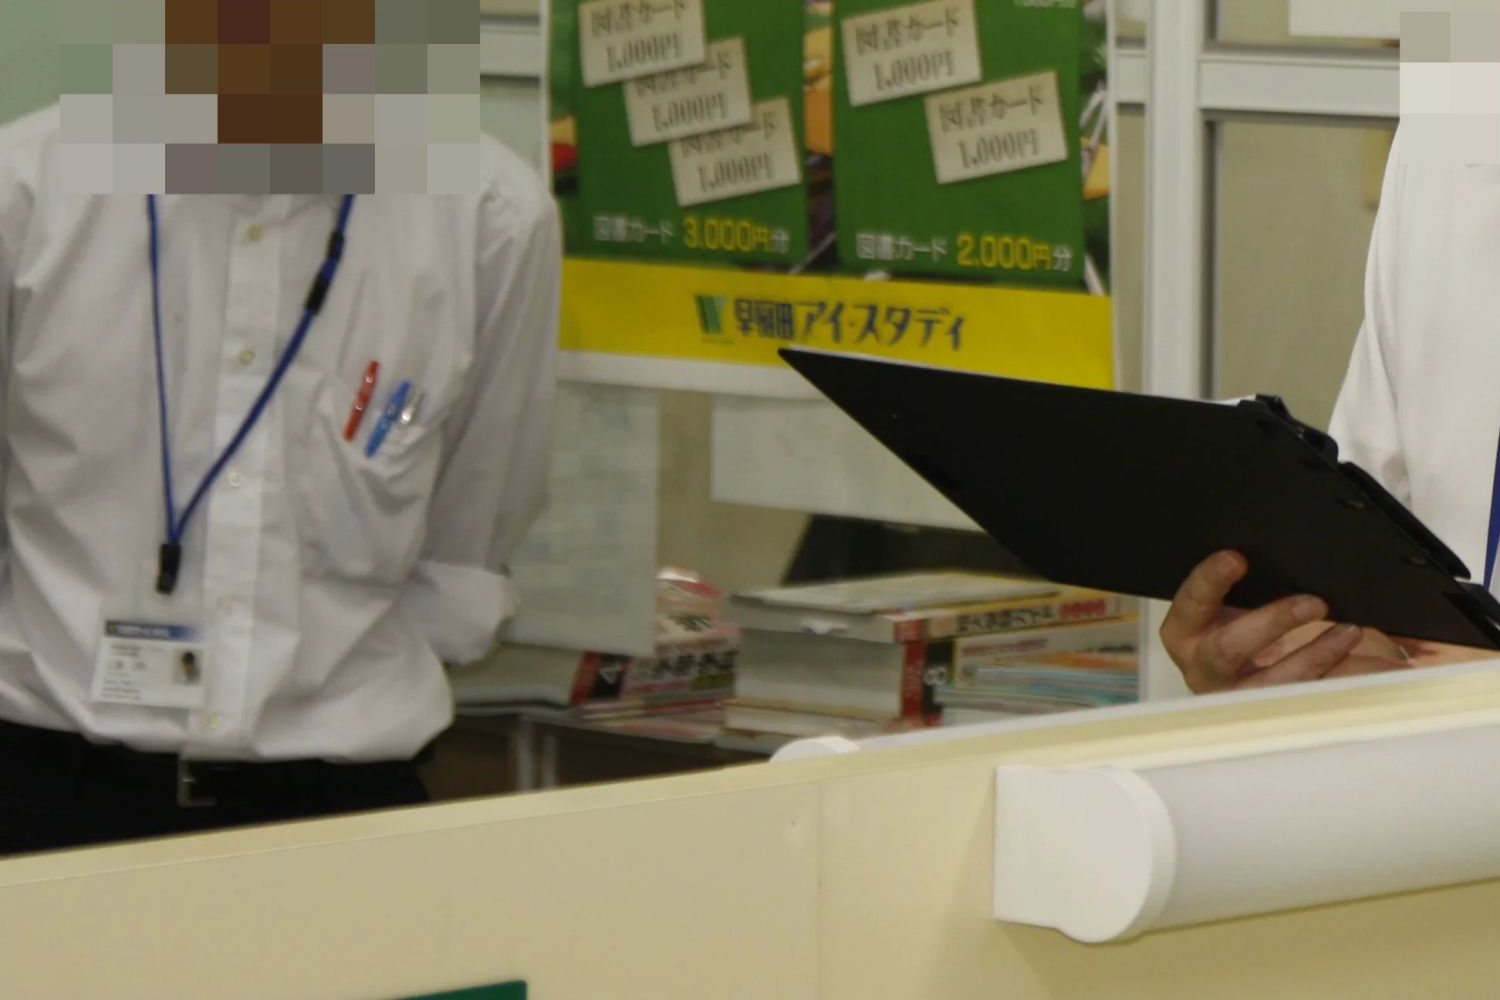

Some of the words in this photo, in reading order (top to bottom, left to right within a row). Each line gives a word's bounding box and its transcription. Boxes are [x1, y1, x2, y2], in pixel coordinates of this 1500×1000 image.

[855, 6, 960, 56] 図書カード
[940, 85, 1043, 132] 図書カード
[593, 215, 675, 244] 図書カード
[856, 231, 948, 263] 図書カード
